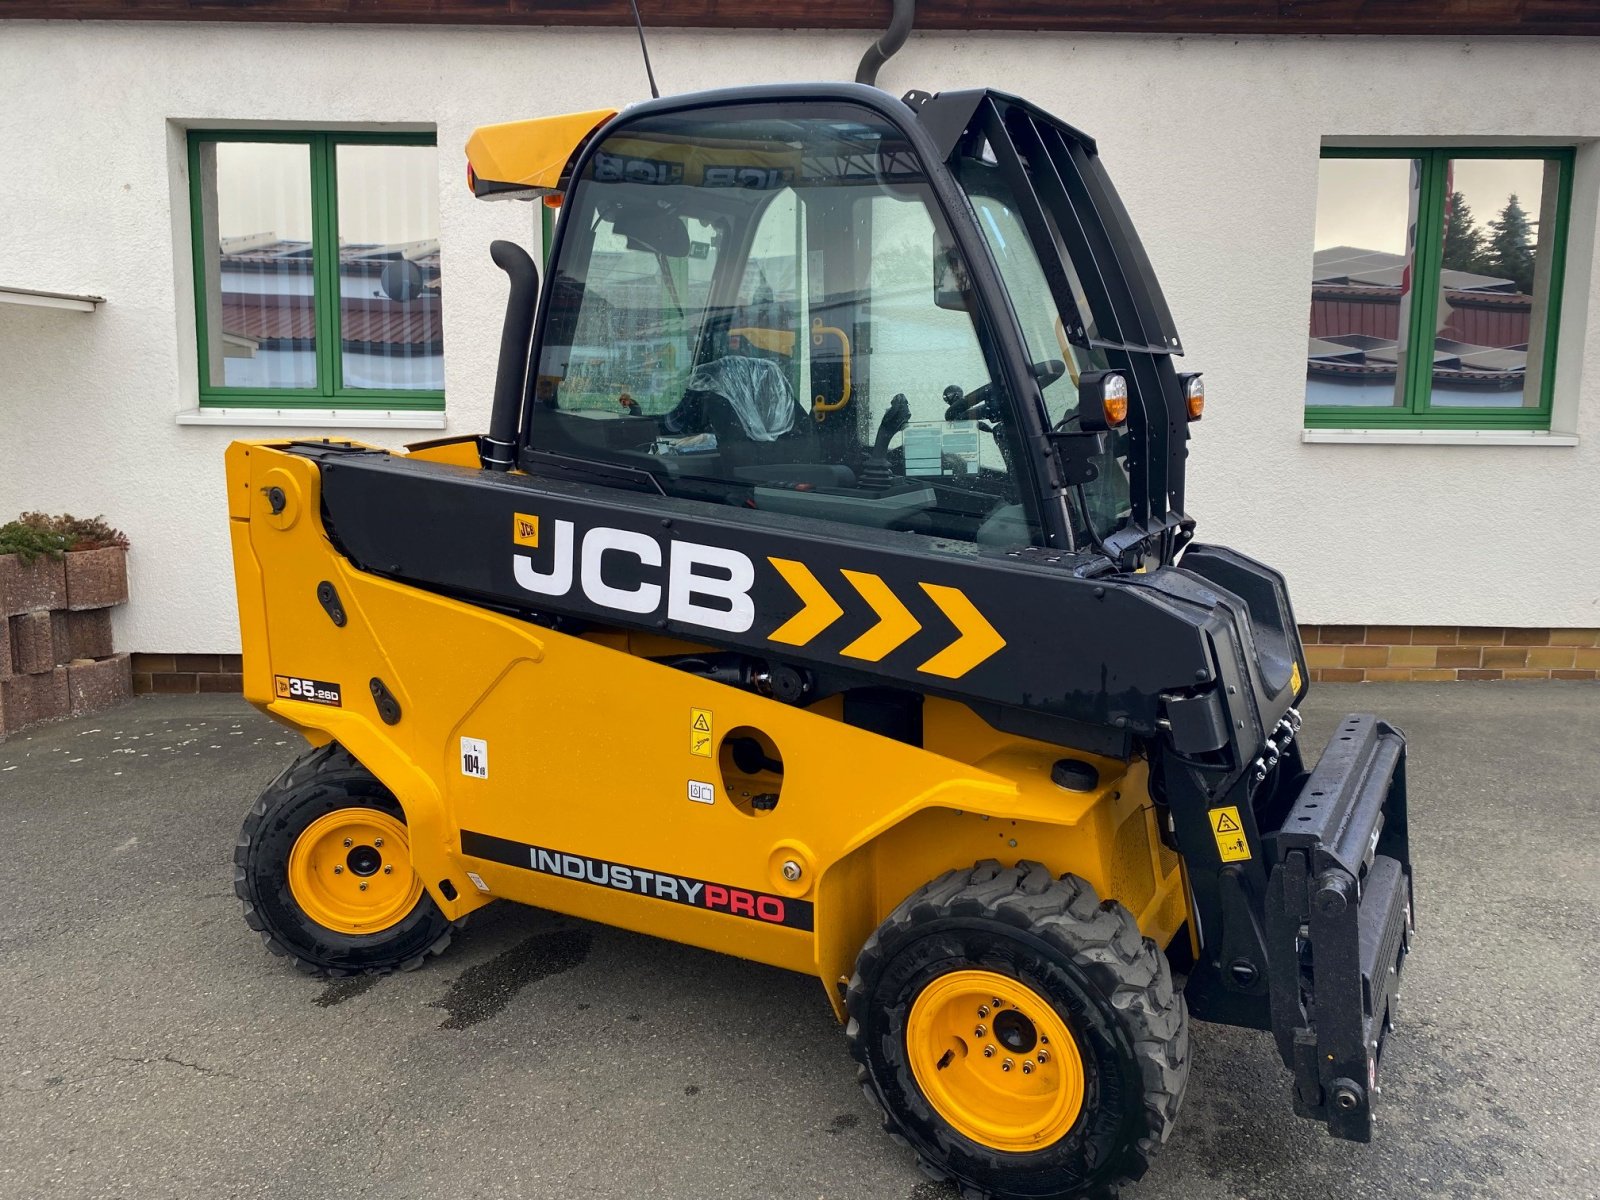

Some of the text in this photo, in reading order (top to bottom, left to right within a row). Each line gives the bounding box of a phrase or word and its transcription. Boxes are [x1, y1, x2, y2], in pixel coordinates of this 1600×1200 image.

[520, 521, 535, 537] JCB
[513, 519, 755, 633] JCB
[464, 754, 479, 773] 104
